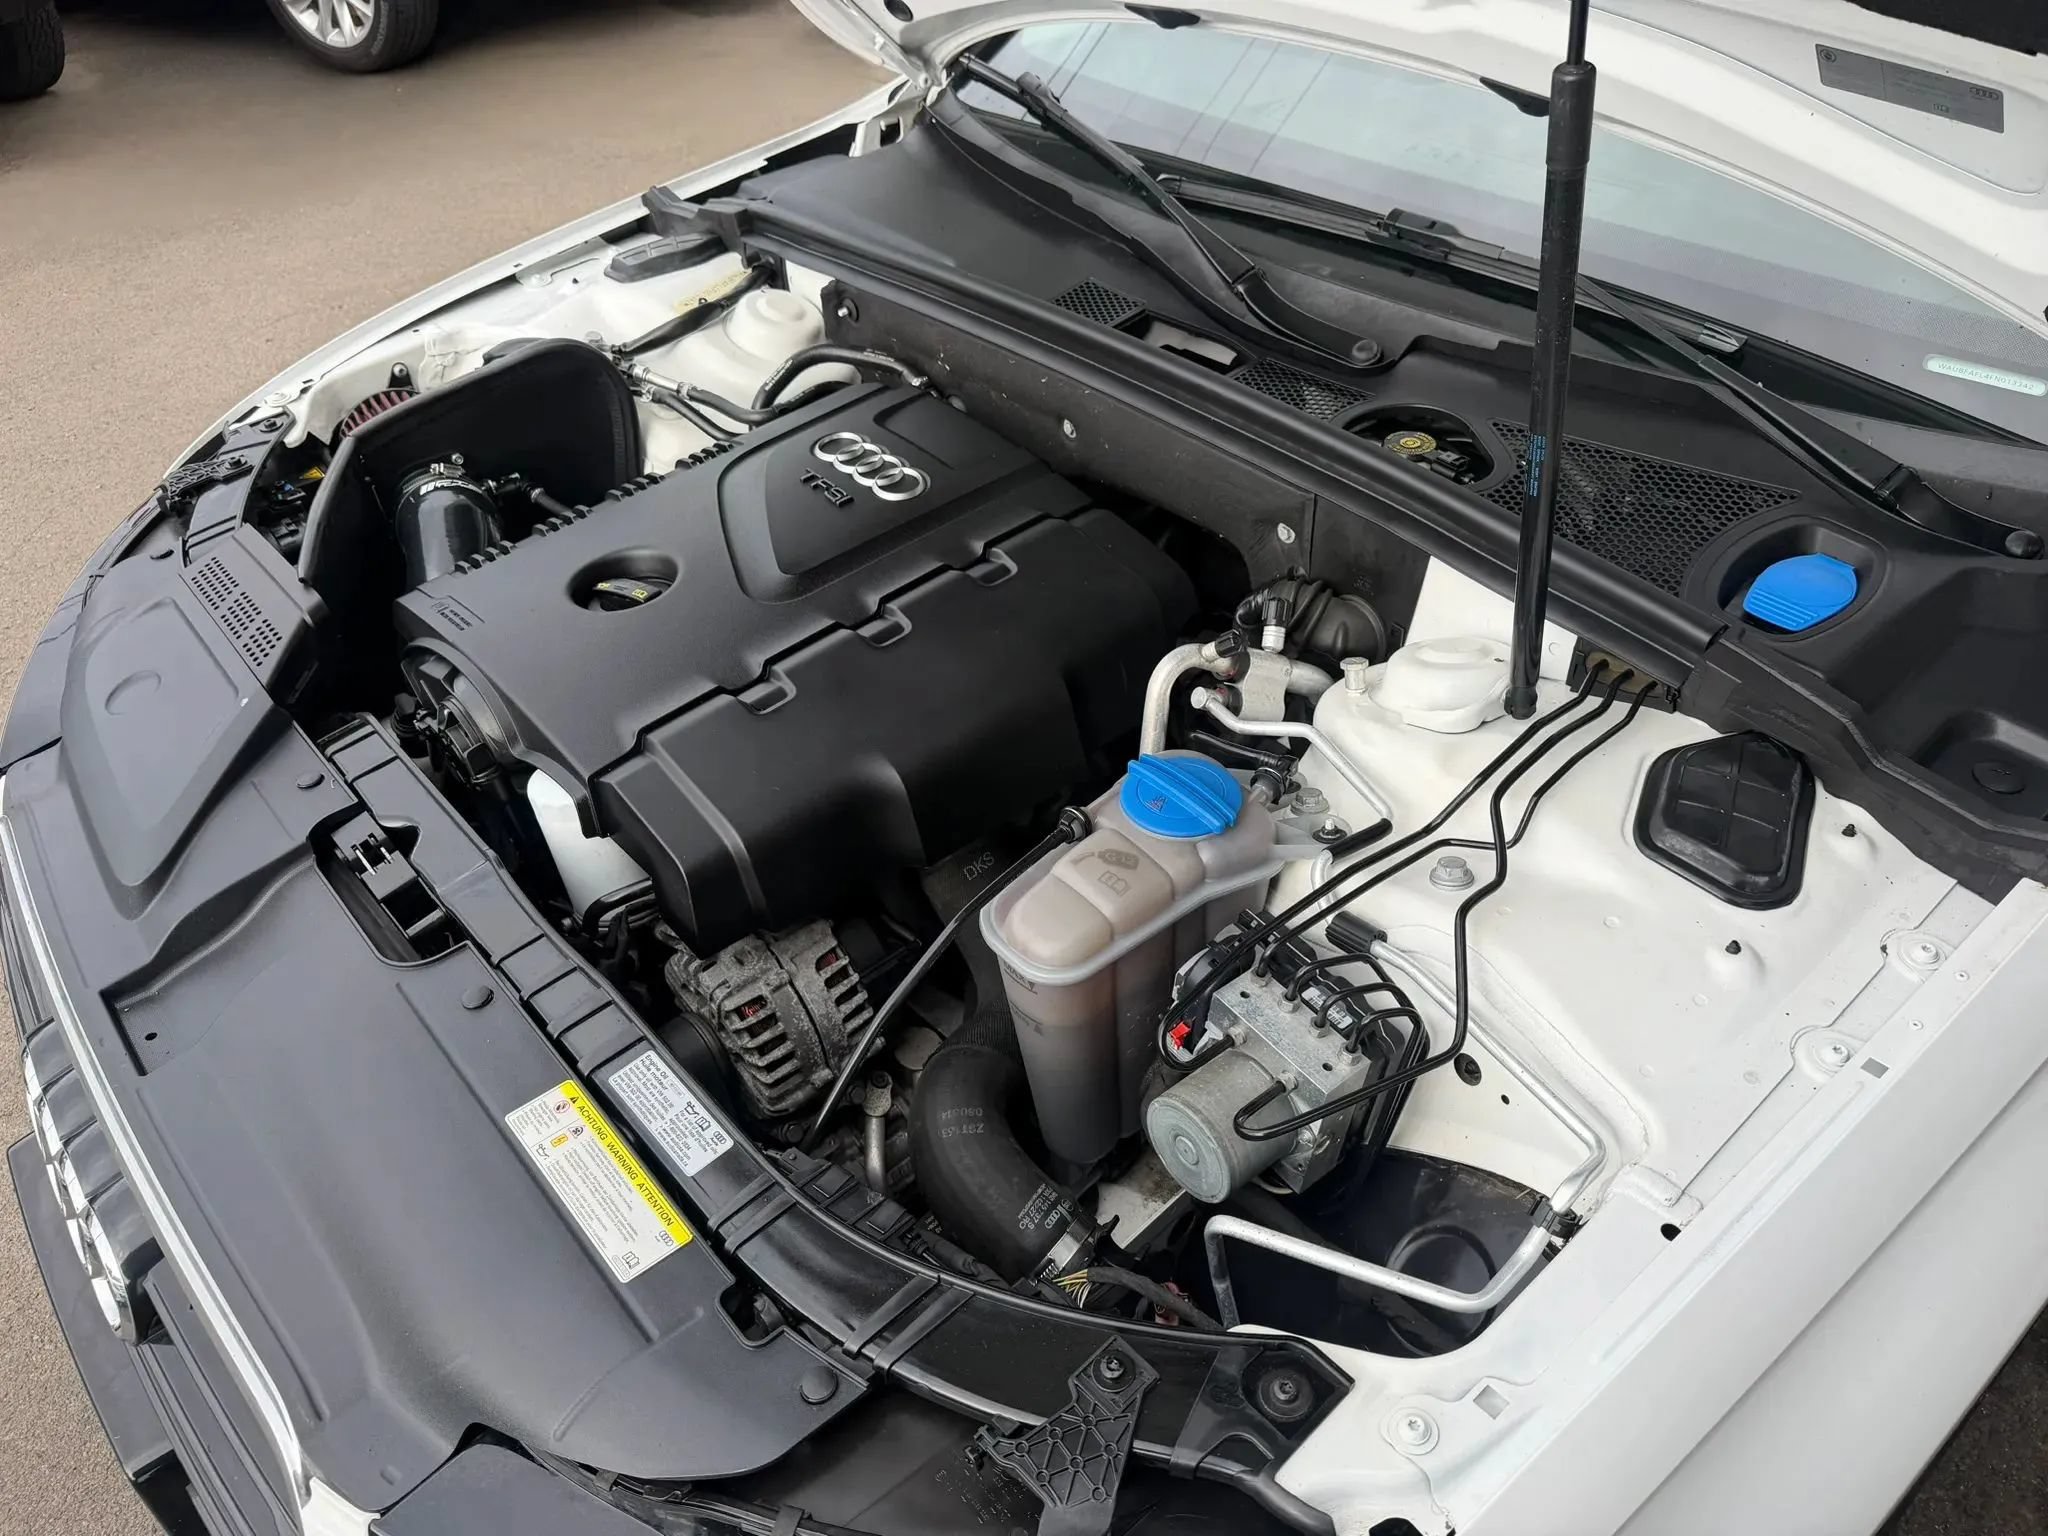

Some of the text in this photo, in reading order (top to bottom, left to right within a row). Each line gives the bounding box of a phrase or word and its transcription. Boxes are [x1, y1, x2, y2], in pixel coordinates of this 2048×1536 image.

[799, 467, 855, 508] TFSI
[963, 851, 995, 881] DKS
[639, 1058, 669, 1090] Huile moteur
[644, 1054, 669, 1079] Engine Oil
[577, 1104, 608, 1140] ACHTUNG
[606, 1141, 639, 1180] WARNING
[636, 1181, 675, 1226] ATTENTION
